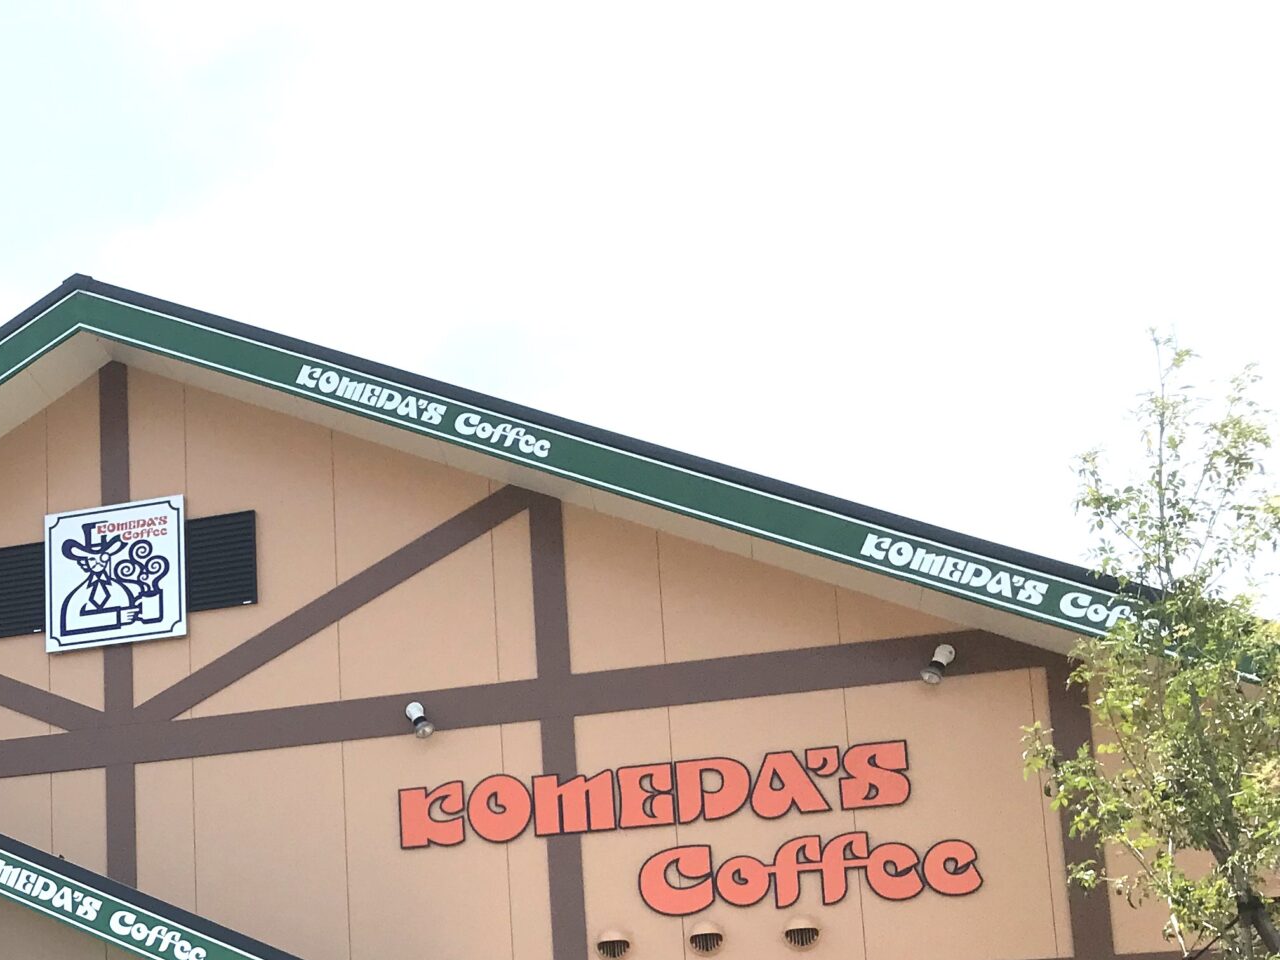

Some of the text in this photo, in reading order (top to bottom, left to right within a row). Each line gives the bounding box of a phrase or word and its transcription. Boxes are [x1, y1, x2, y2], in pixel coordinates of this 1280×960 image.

[296, 363, 551, 459] KOMEDA'S Coffee
[97, 515, 167, 534] KOMEDA'S
[122, 528, 167, 541] Coffee
[860, 533, 1170, 645] KOMEDA'S Cof
[399, 740, 911, 849] KOMEDA'S
[638, 831, 983, 916] Coffee
